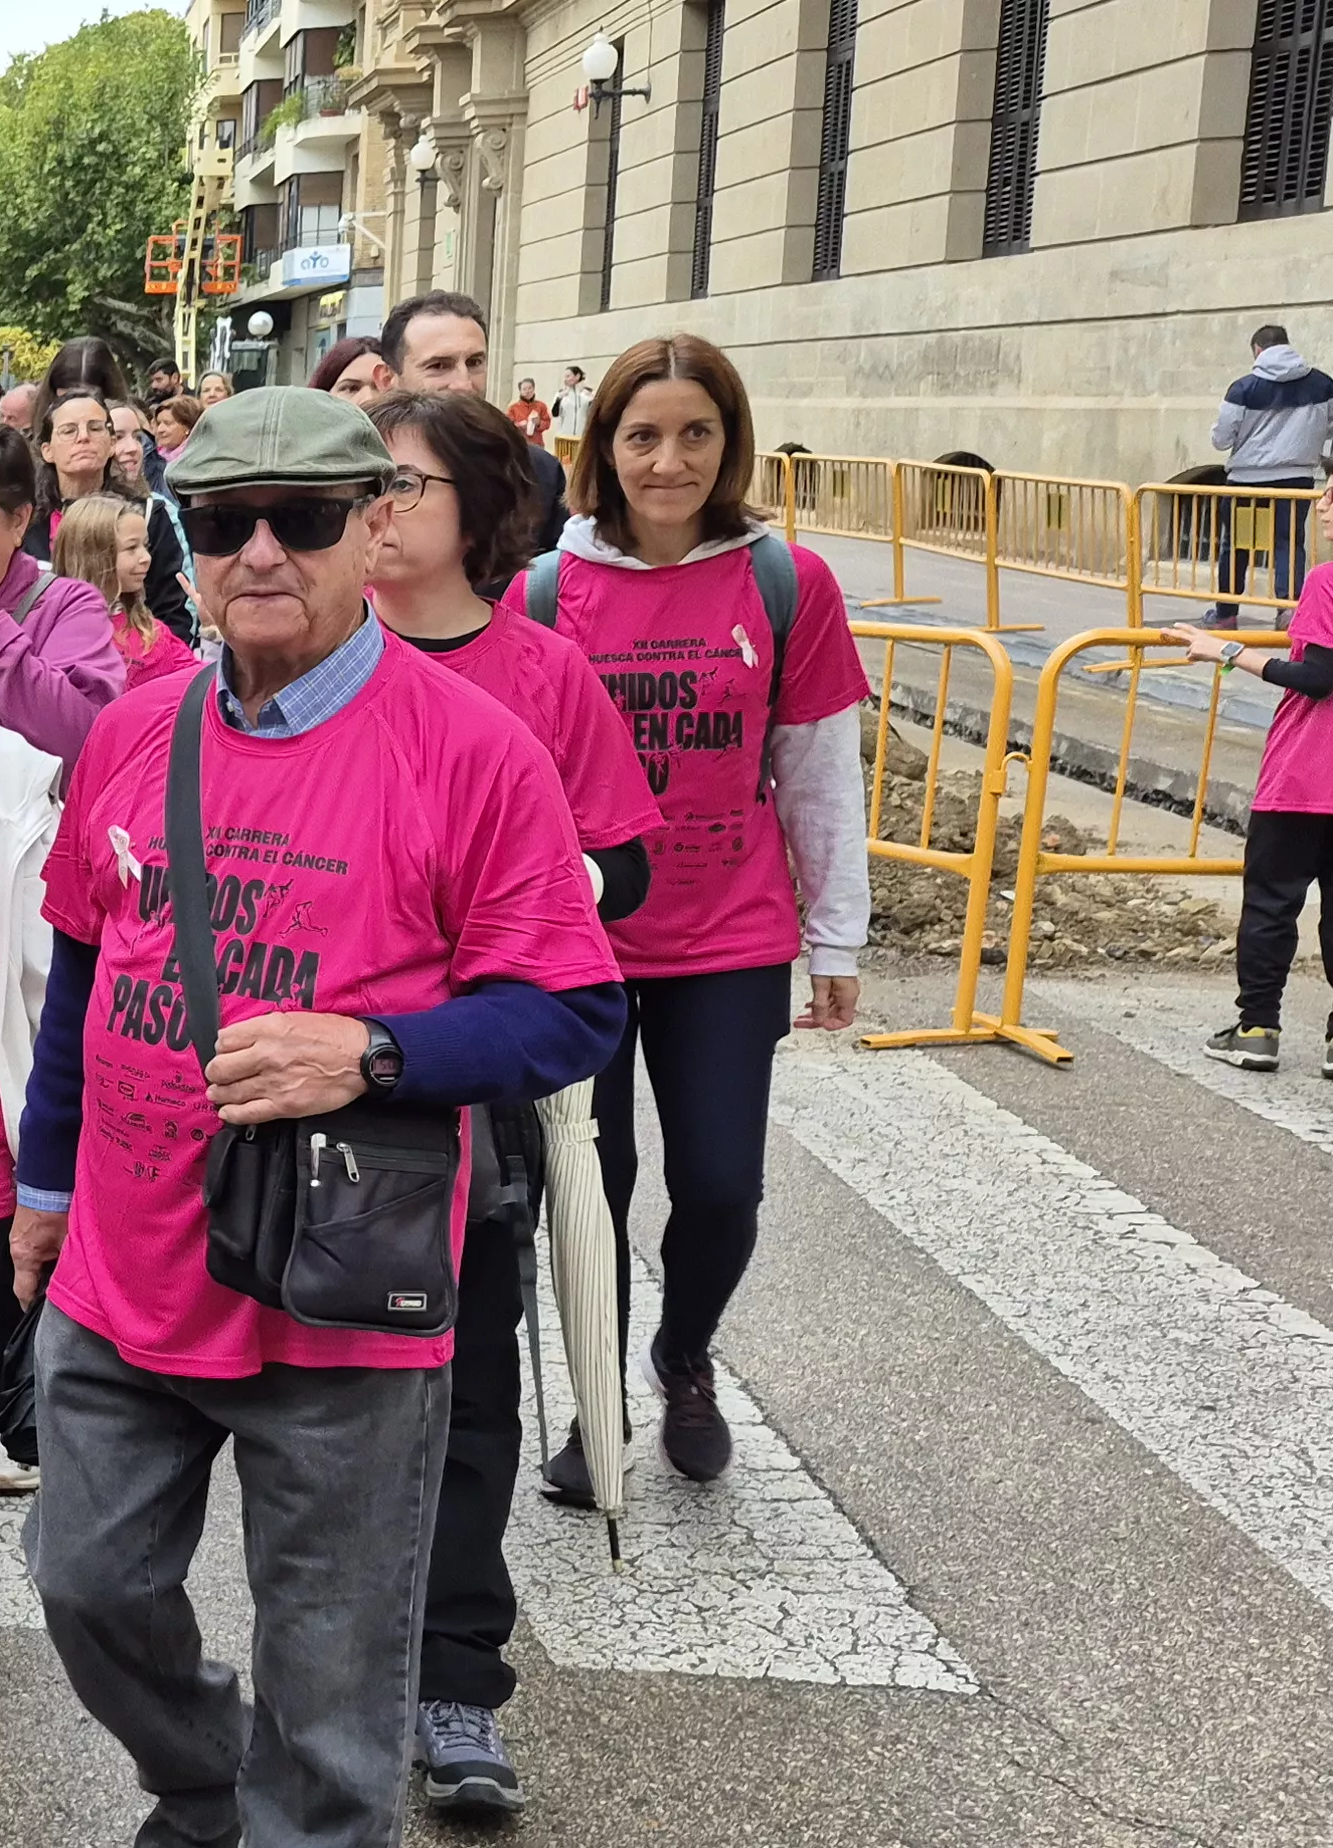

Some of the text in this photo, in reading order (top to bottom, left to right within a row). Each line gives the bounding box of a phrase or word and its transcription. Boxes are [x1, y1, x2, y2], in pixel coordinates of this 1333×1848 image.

[636, 651, 685, 661] CONTRA
[688, 650, 701, 659] EL
[651, 638, 706, 649] CARRERA
[635, 713, 668, 750] EN
[224, 827, 291, 848] CARRERA
[205, 843, 261, 863] CONTRA
[282, 850, 349, 876] CÁNCER
[217, 938, 321, 1010] CADA
[106, 973, 193, 1053] PASO
